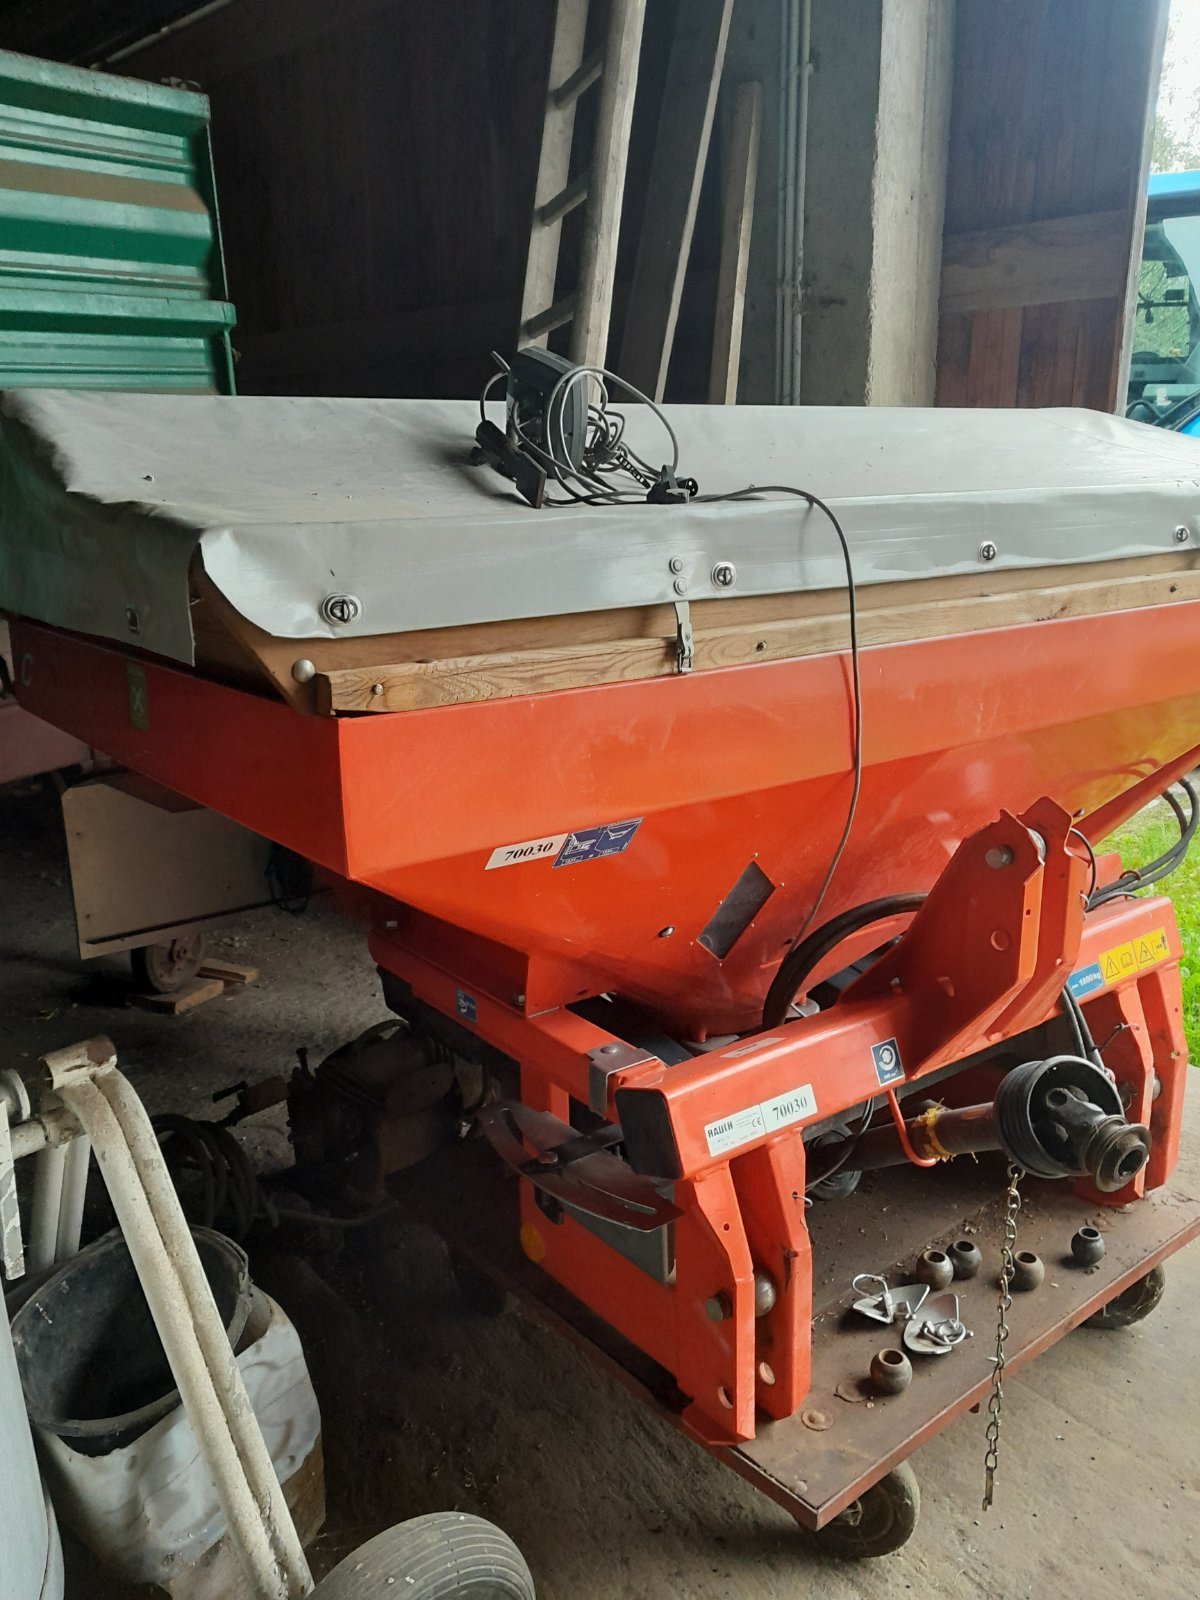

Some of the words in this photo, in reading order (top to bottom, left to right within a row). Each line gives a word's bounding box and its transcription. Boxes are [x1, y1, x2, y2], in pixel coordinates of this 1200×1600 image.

[504, 842, 554, 861] 70030
[772, 1095, 808, 1121] 70030
[707, 1120, 734, 1139] RAUCH
